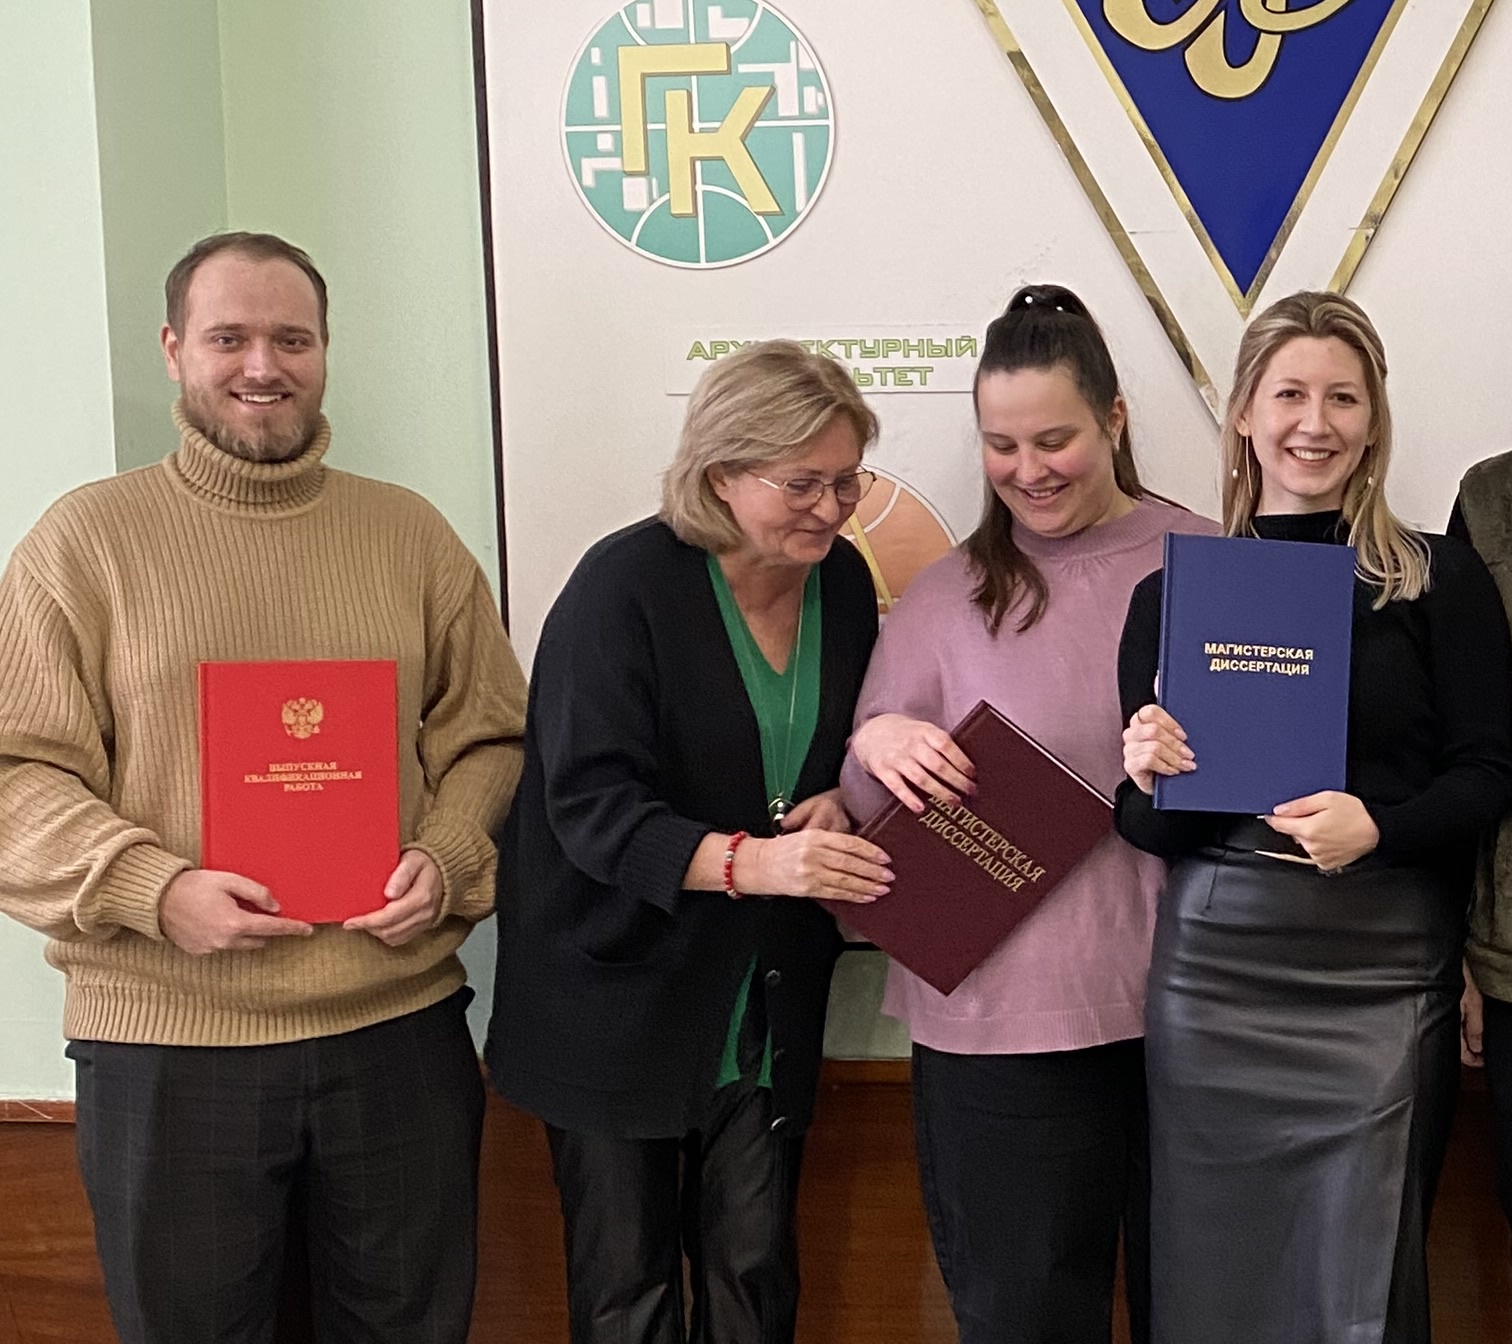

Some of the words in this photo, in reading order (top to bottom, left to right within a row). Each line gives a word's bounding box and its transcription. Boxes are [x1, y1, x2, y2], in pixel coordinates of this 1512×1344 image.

[617, 41, 784, 218] ГК
[1204, 642, 1314, 661] МАГИСТЕРСКАЯ
[1209, 658, 1310, 676] ДИССЕРТАЦИЯ
[268, 762, 337, 773] ВЫПУСКНАЯ
[283, 782, 324, 792] РАБОТА
[918, 809, 1026, 893] ДИССЕРТАЦИЯ
